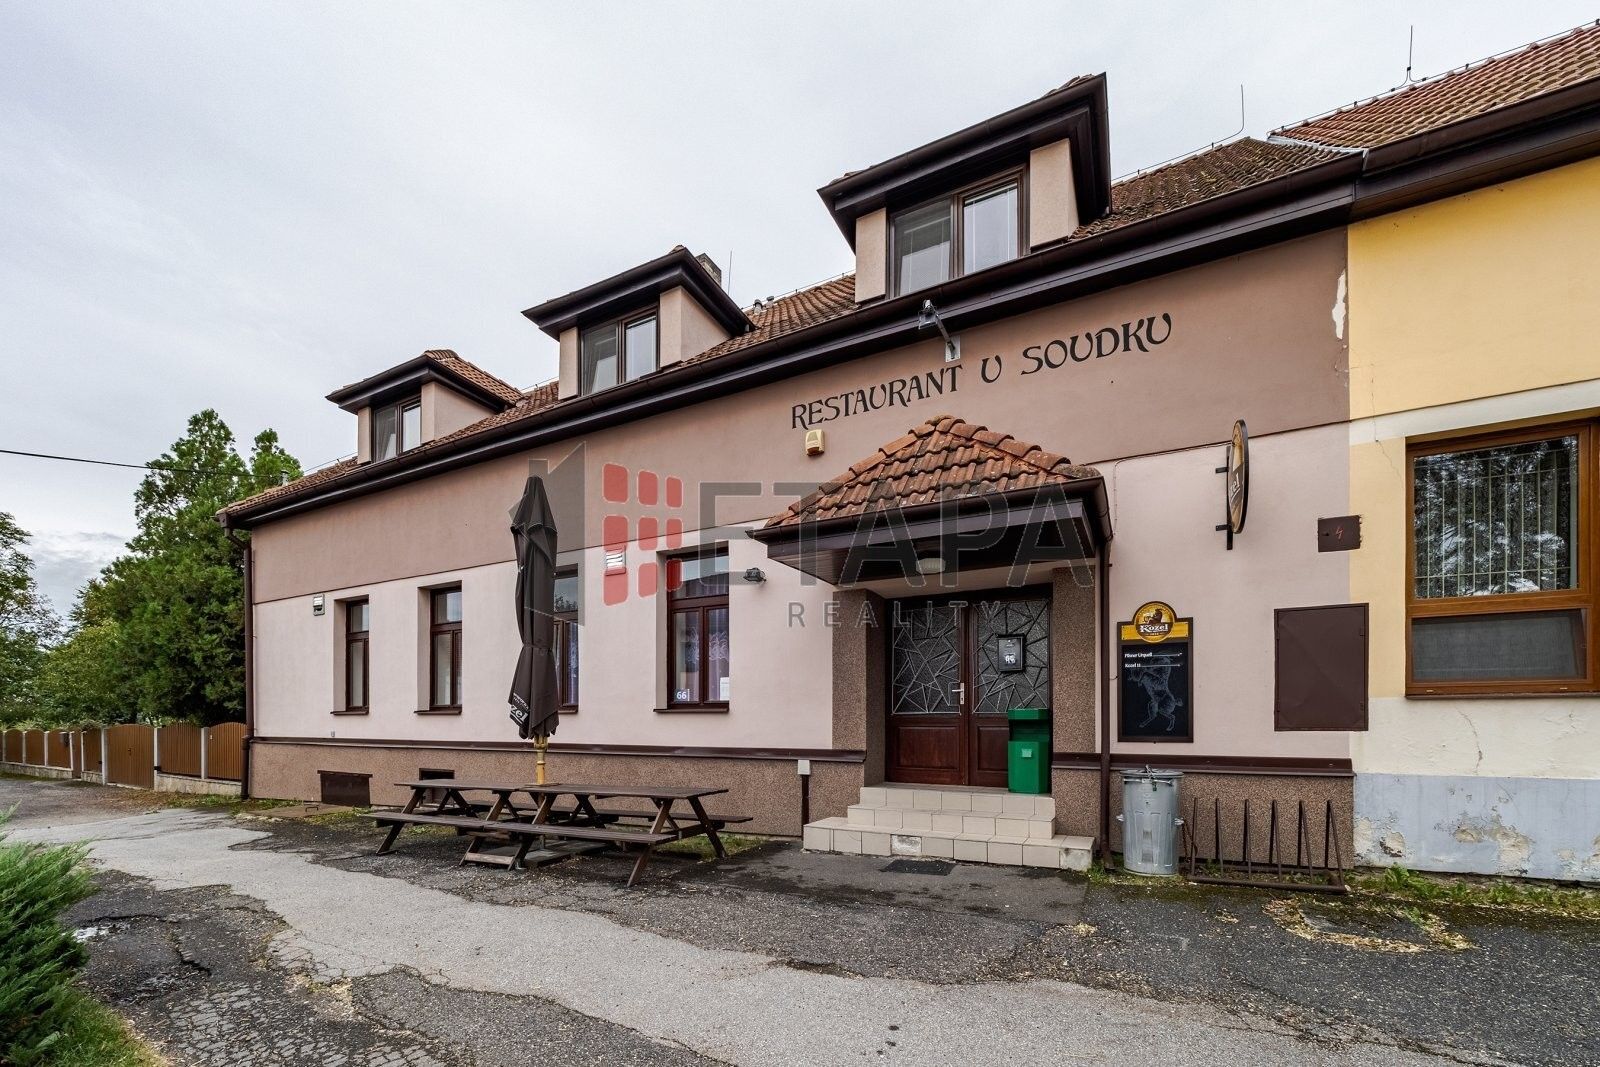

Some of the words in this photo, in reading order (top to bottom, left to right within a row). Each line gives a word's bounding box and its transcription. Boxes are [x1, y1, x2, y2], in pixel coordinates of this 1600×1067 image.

[791, 364, 963, 430] RESTAURANT
[980, 355, 1003, 384] U
[1020, 312, 1172, 376] SOUDKU
[1140, 624, 1168, 633] Kozel
[676, 691, 687, 700] 66
